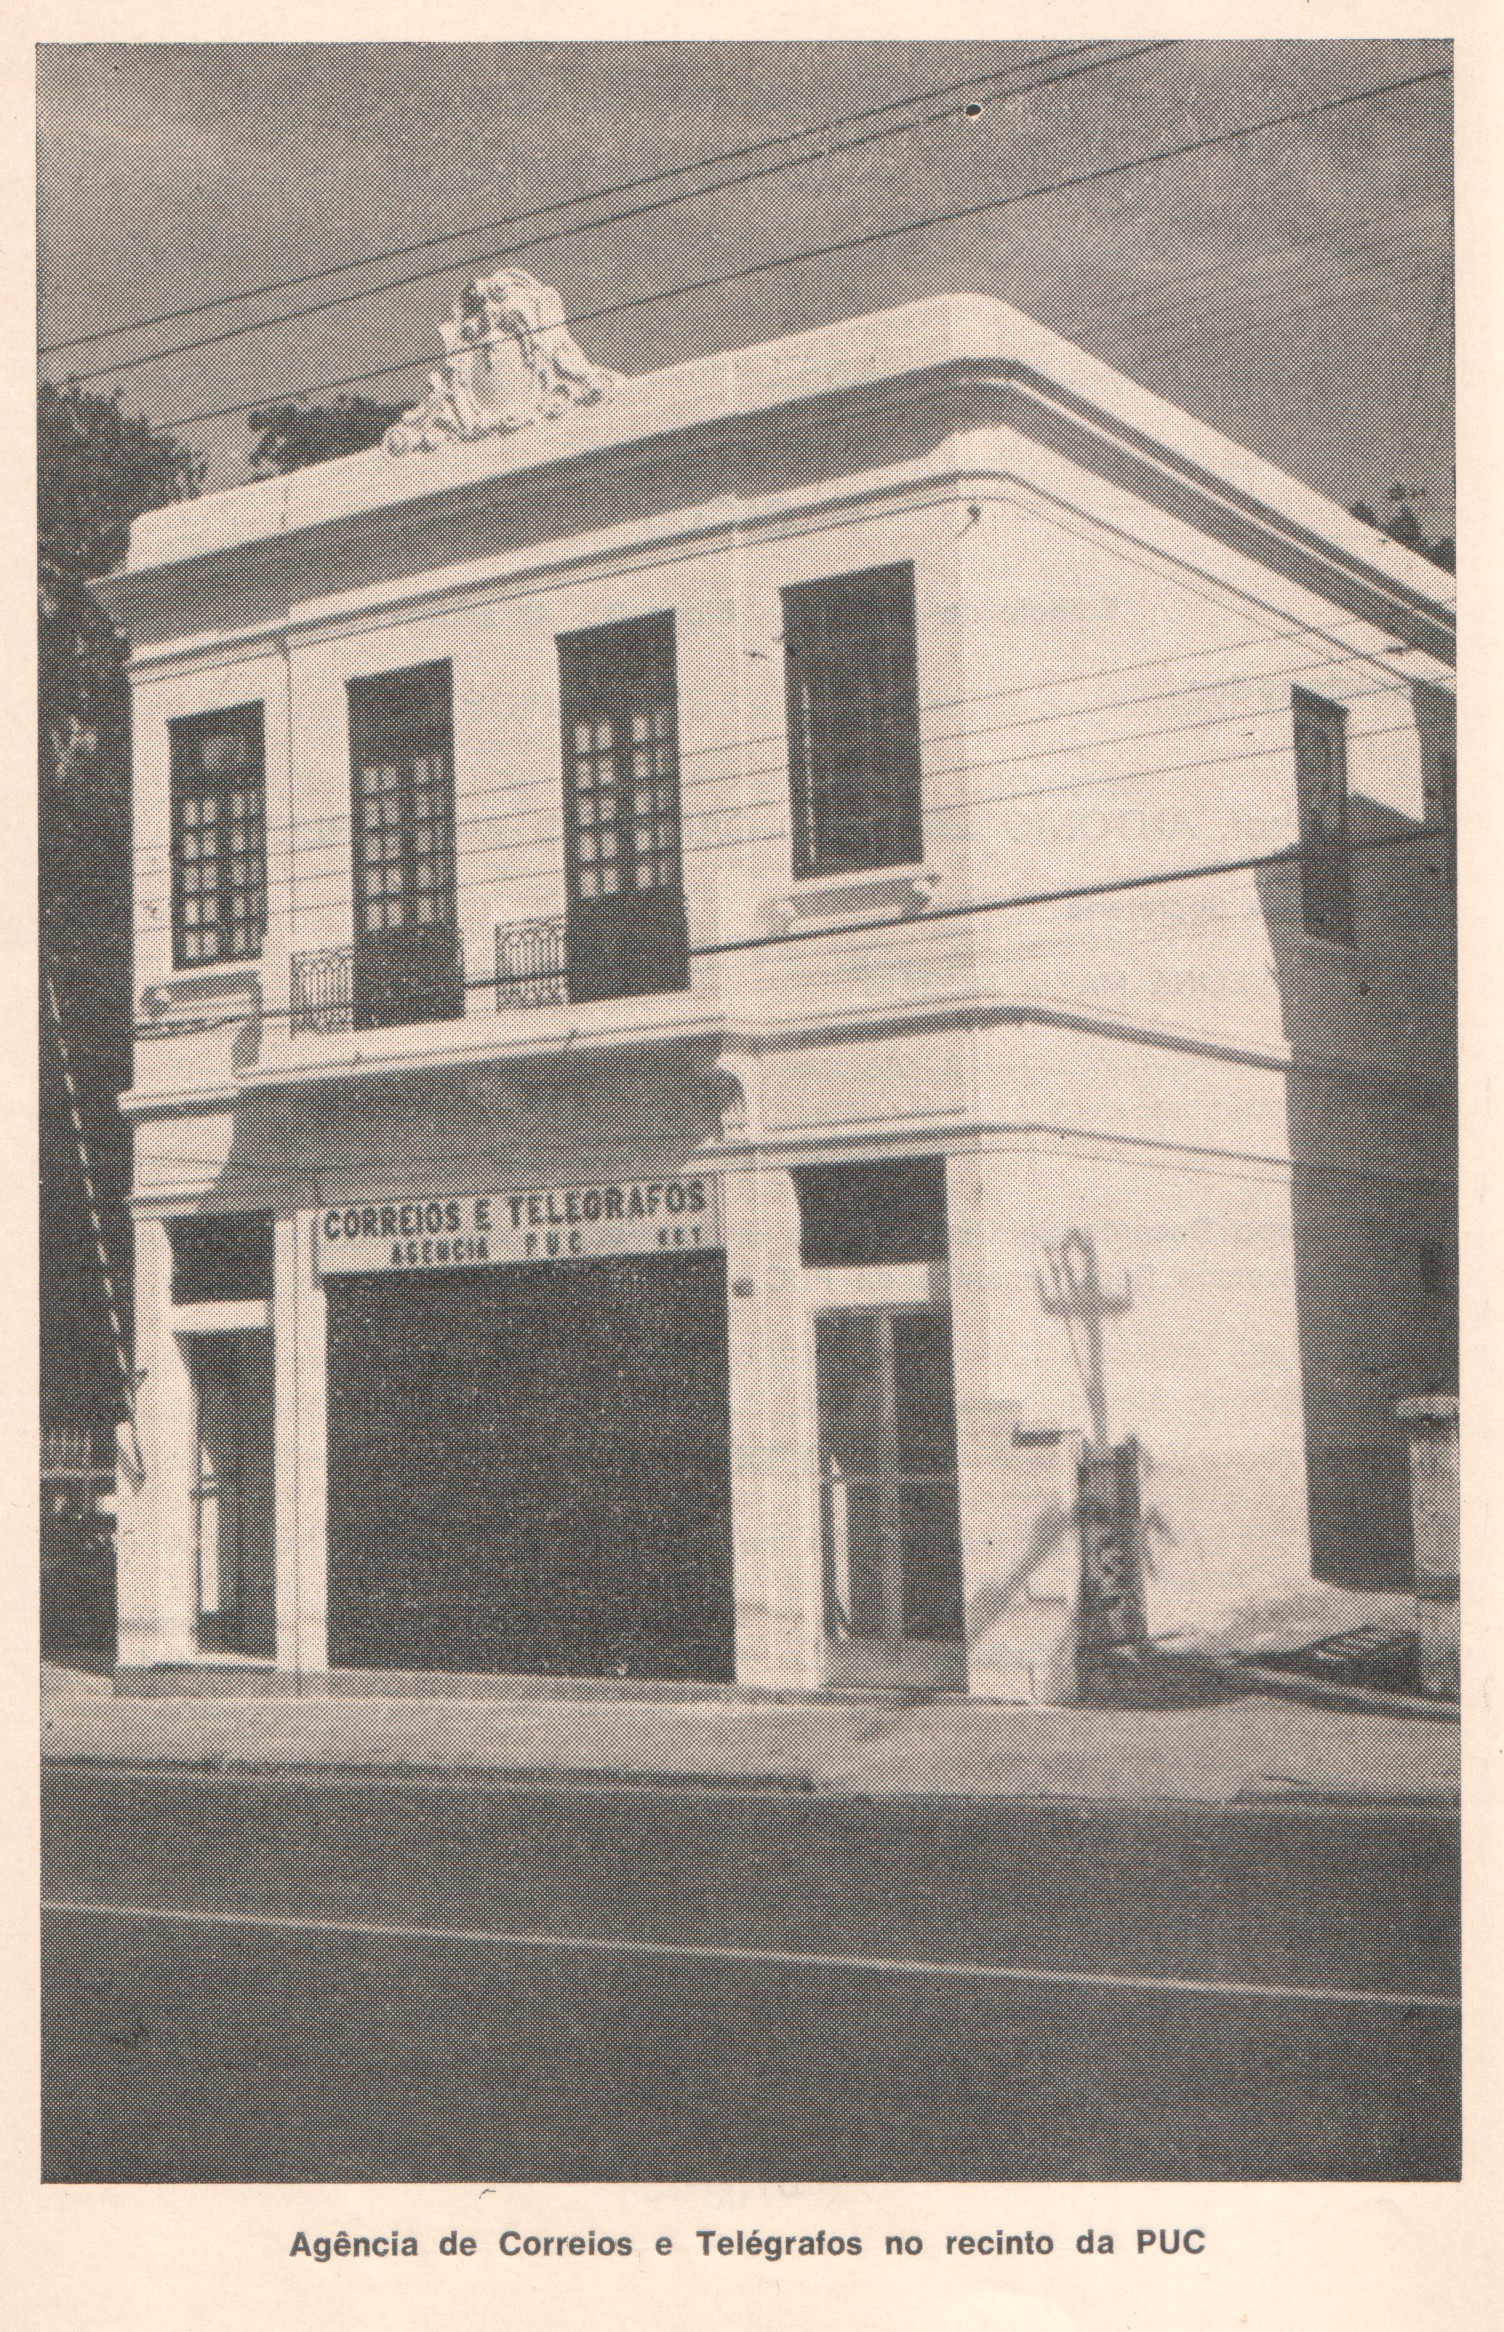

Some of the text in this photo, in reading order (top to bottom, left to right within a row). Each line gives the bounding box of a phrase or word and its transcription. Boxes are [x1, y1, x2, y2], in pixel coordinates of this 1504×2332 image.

[324, 1181, 706, 1240] CORREIOS E TELEGRAFOS
[390, 1237, 490, 1265] AGENCIA
